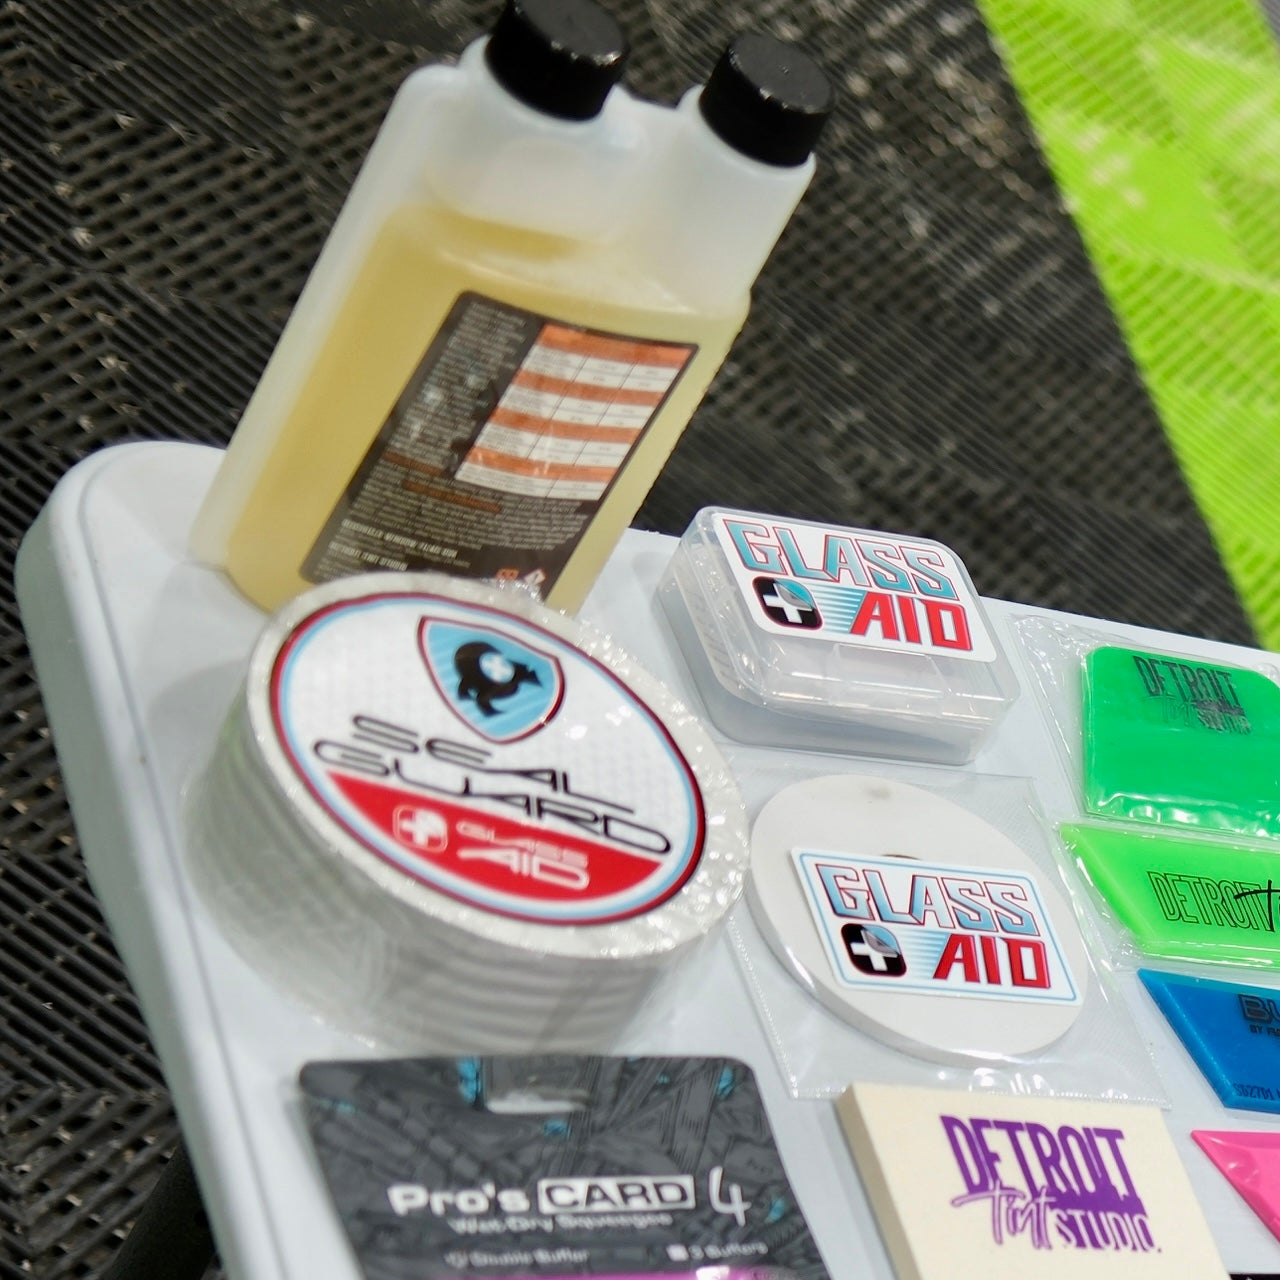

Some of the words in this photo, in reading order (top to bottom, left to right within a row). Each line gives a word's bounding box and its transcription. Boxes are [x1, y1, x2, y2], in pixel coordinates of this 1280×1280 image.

[723, 518, 960, 601] GLASS
[849, 591, 973, 650] AID
[1133, 655, 1244, 708] DETROIT
[353, 715, 635, 814] SEAL
[314, 740, 671, 855] GUARD
[456, 820, 588, 868] GLASS
[456, 848, 590, 890] AID
[815, 863, 1041, 937] GLASS
[1147, 870, 1275, 932] DETROIT
[933, 933, 1052, 989] AID
[1249, 1024, 1264, 1035] BY
[940, 1115, 1143, 1206] DETROIT
[387, 1180, 531, 1217] Pro's
[540, 1178, 693, 1212] CARD
[708, 1165, 754, 1227] 4
[556, 1212, 674, 1231] Squeegee
[950, 1179, 1057, 1251] Tint
[704, 1242, 769, 1259] Buffers
